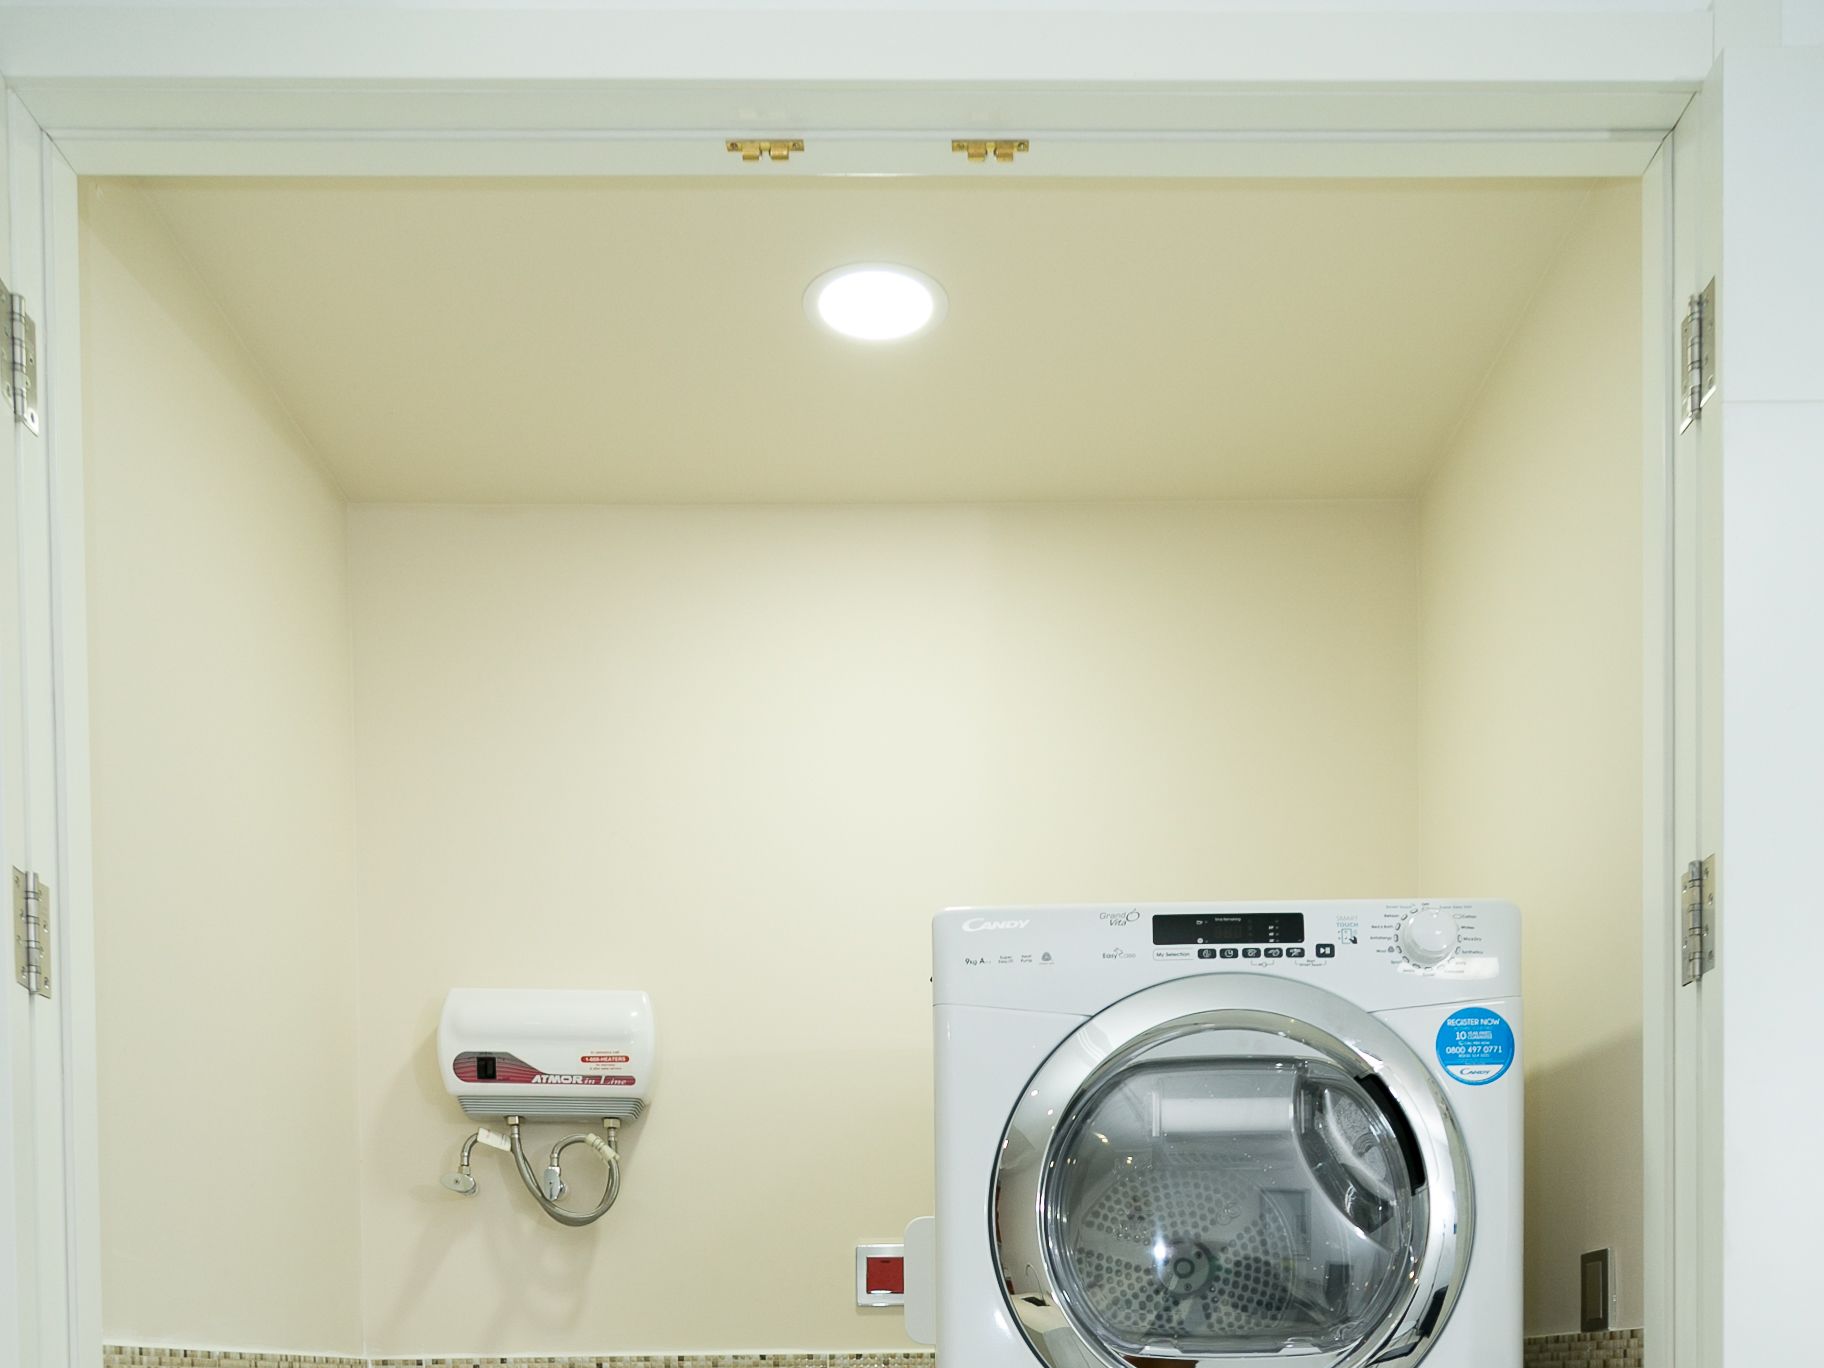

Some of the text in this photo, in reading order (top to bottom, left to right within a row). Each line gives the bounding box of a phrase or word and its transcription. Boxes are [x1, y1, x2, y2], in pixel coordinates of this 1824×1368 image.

[962, 917, 1030, 932] CANDY
[1446, 1018, 1479, 1026] REGISTER
[1455, 1031, 1467, 1040] 10
[1445, 1046, 1466, 1054] 0800
[1482, 1045, 1502, 1053] 0771
[531, 1074, 583, 1084] ATMOR
